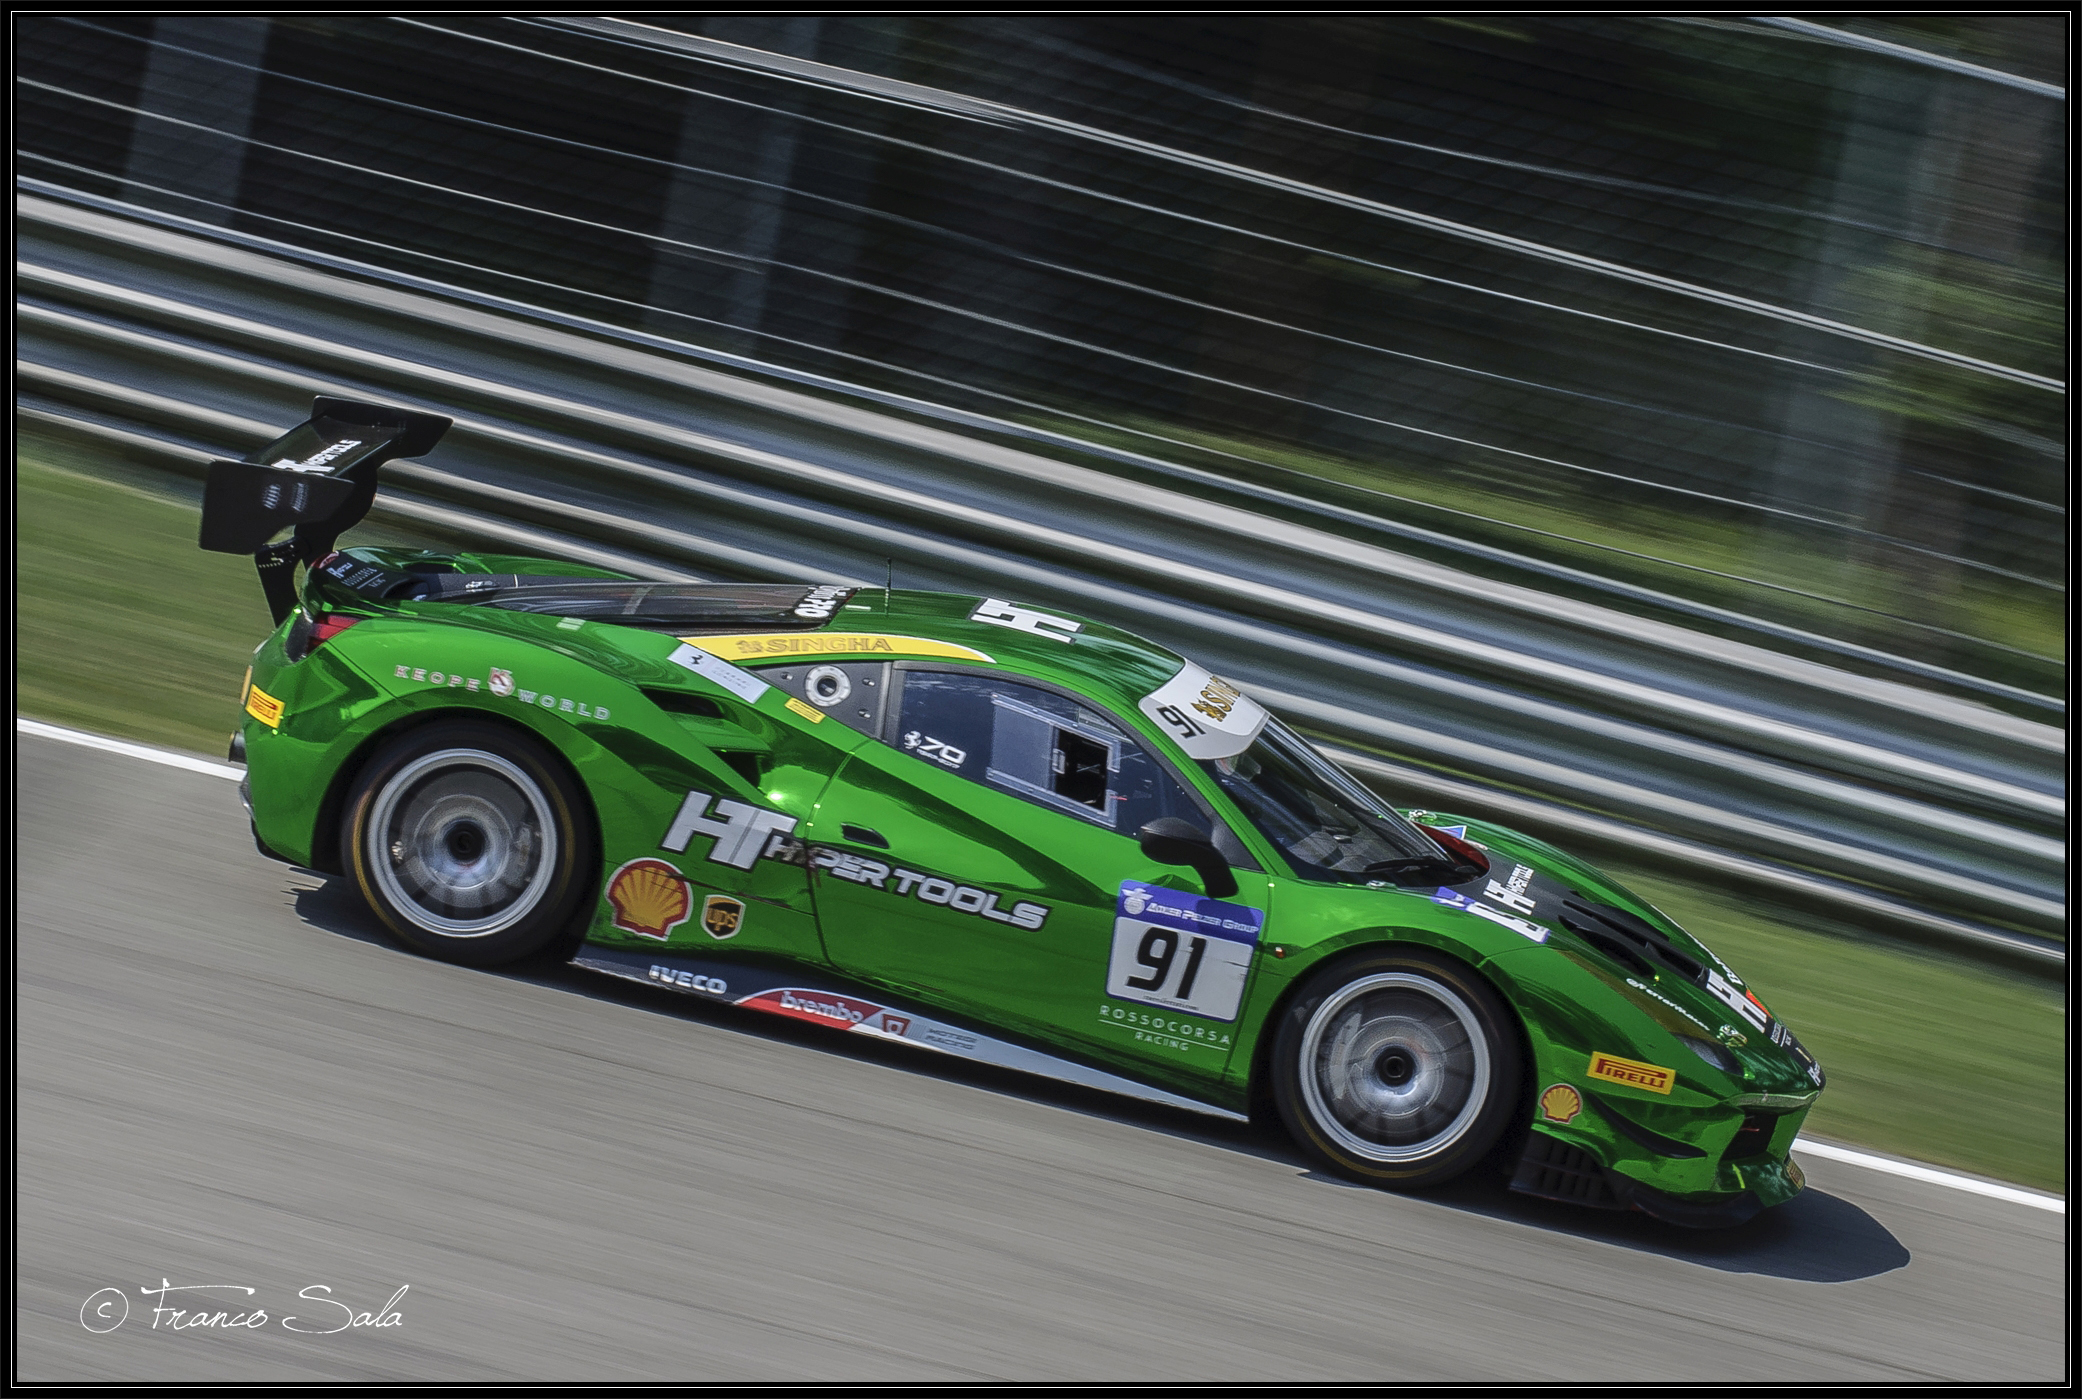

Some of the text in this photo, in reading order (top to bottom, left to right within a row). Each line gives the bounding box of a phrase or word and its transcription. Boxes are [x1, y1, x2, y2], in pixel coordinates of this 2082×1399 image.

[766, 637, 893, 654] SINGHA
[394, 664, 611, 721] KEOPE WORLD
[1156, 704, 1206, 739] 91
[919, 735, 967, 765] 70
[661, 790, 798, 870] HT
[649, 964, 727, 995] IVECO
[1126, 926, 1207, 1001] 91
[779, 991, 864, 1023] brembo
[1099, 1005, 1231, 1045] ROSSOCORSA
[1135, 1031, 1189, 1052] RACING
[1594, 1057, 1668, 1089] PIRELLI
